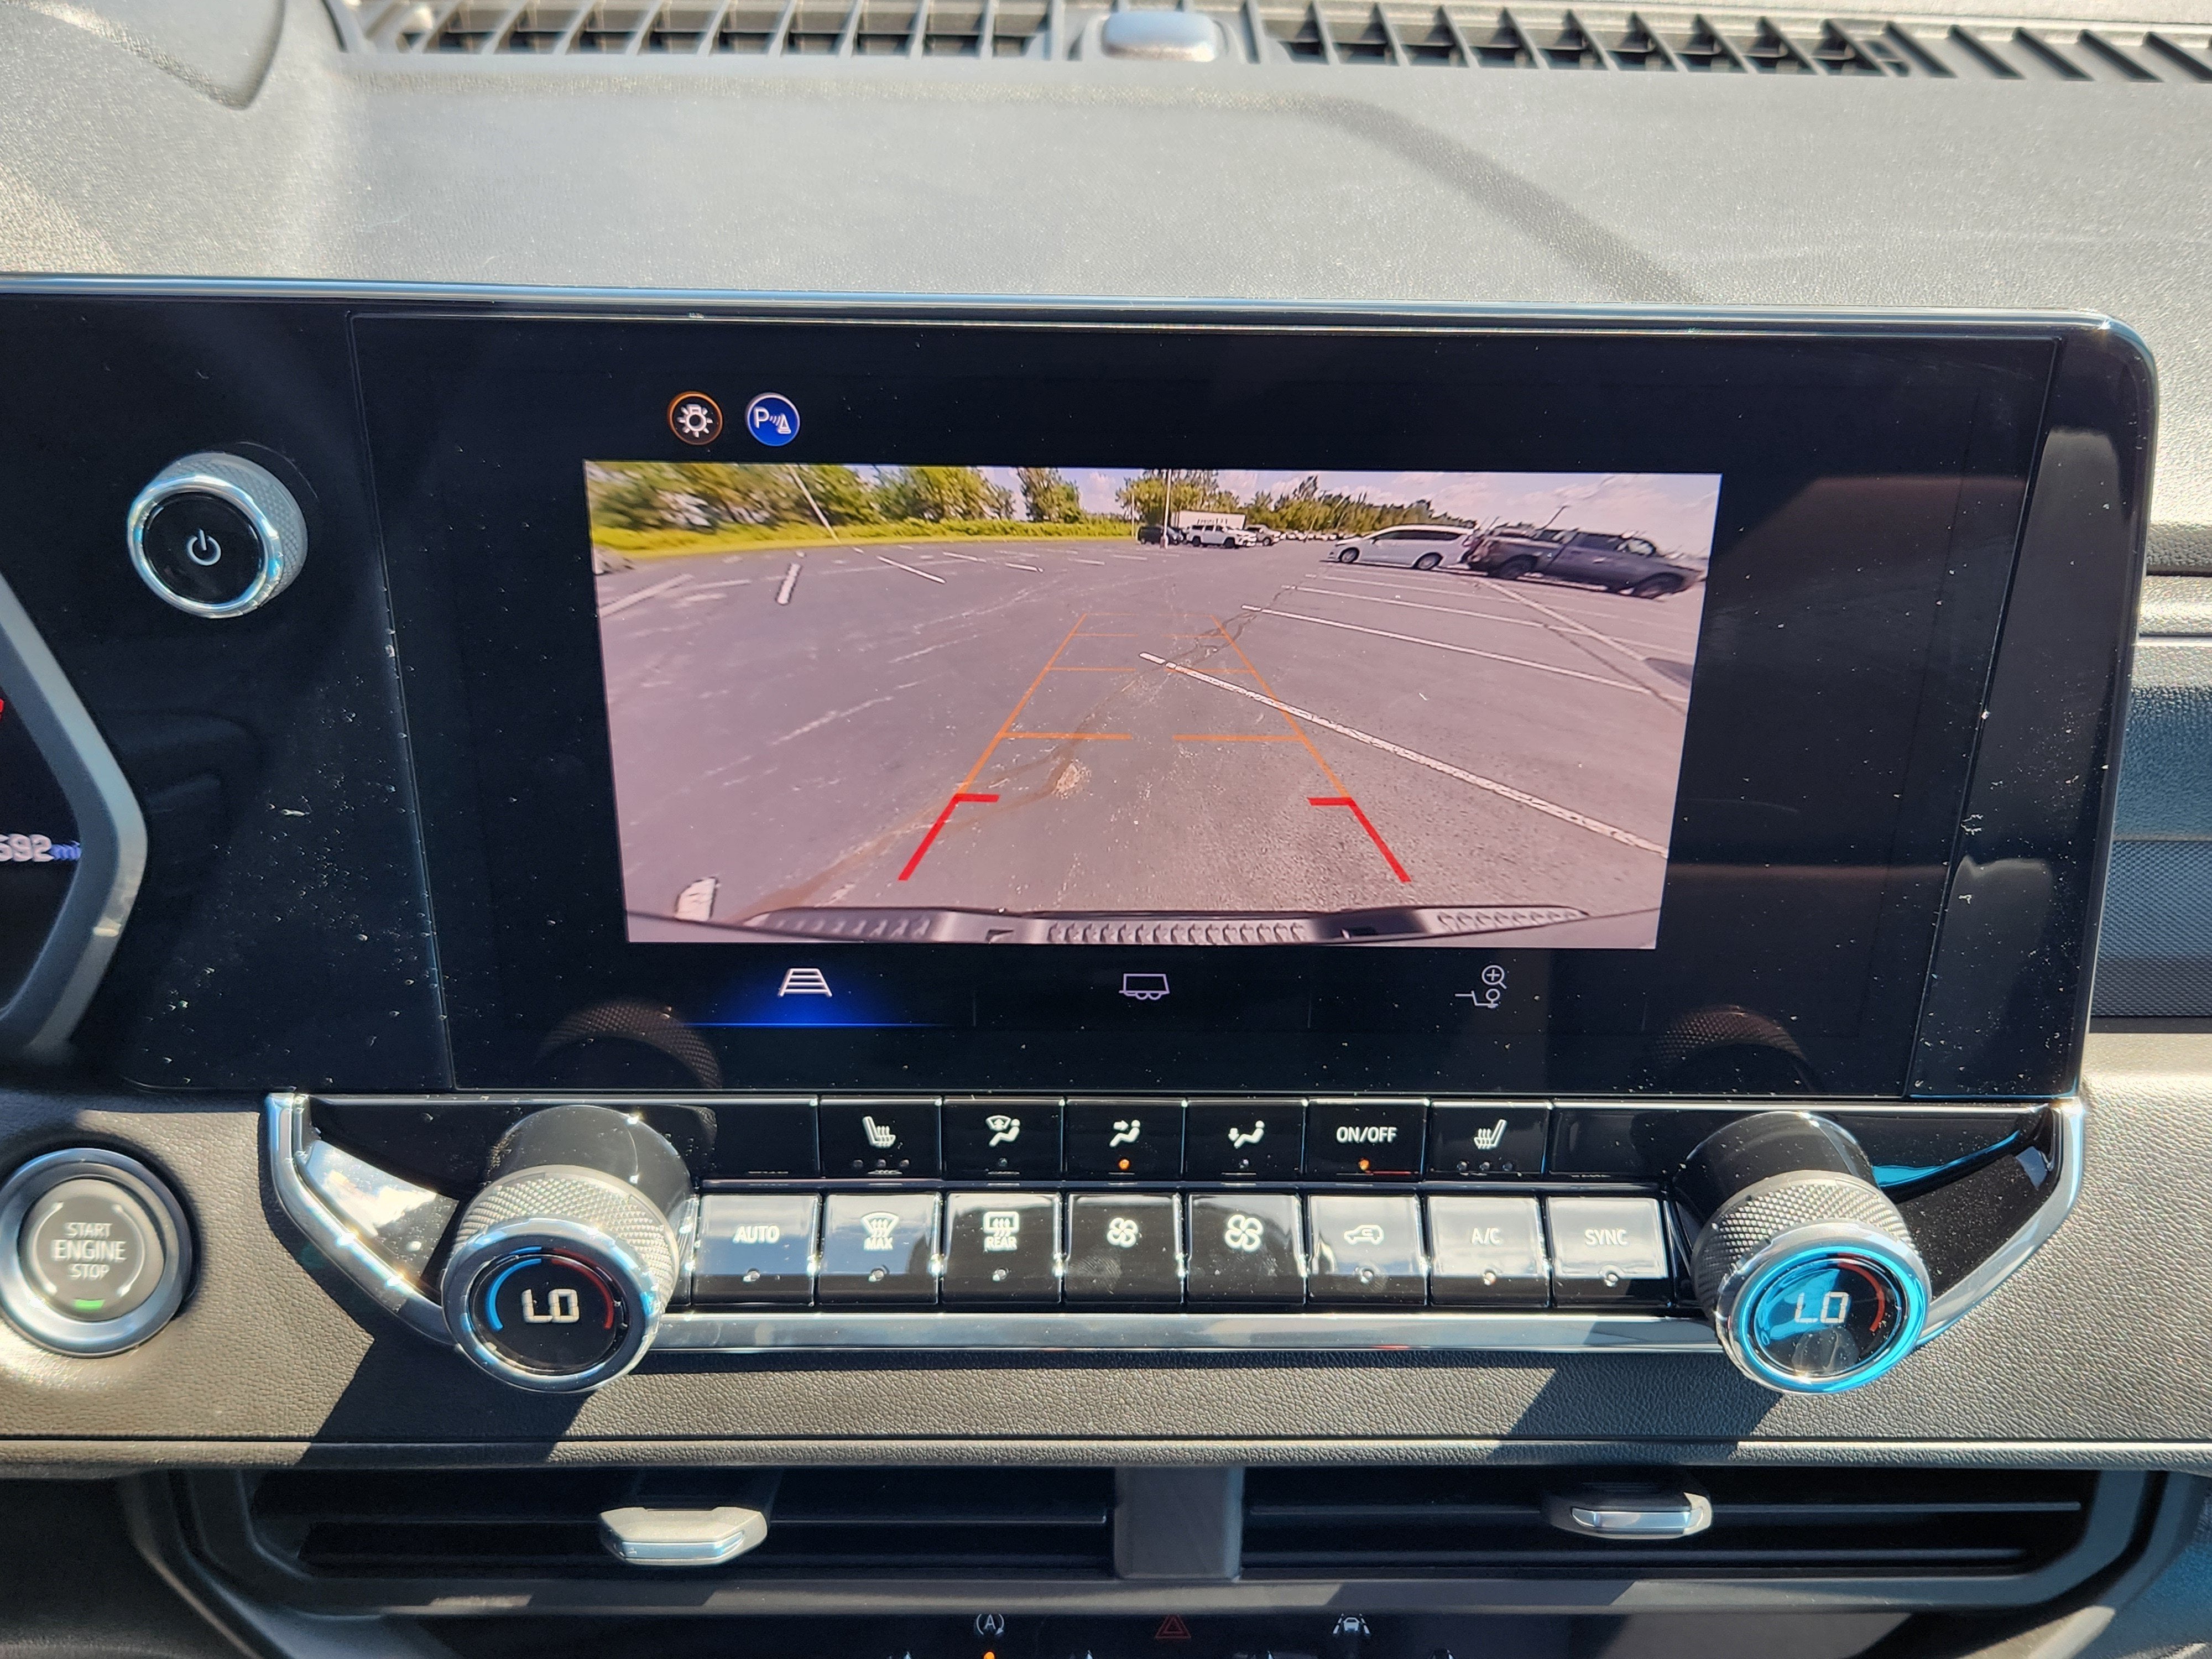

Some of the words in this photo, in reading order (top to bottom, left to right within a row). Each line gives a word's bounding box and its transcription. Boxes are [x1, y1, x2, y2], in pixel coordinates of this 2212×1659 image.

[1336, 1126, 1397, 1143] ON/OFF
[64, 1222, 112, 1238] START
[732, 1225, 780, 1244] AUTO
[1471, 1228, 1500, 1244] A/C
[1585, 1228, 1627, 1245] SYNC
[51, 1239, 127, 1261] ENGINE
[863, 1237, 893, 1250] MAX
[984, 1237, 1017, 1251] REAR
[68, 1263, 110, 1280] STOP
[521, 1288, 579, 1323] LO
[1794, 1292, 1849, 1323] LO
